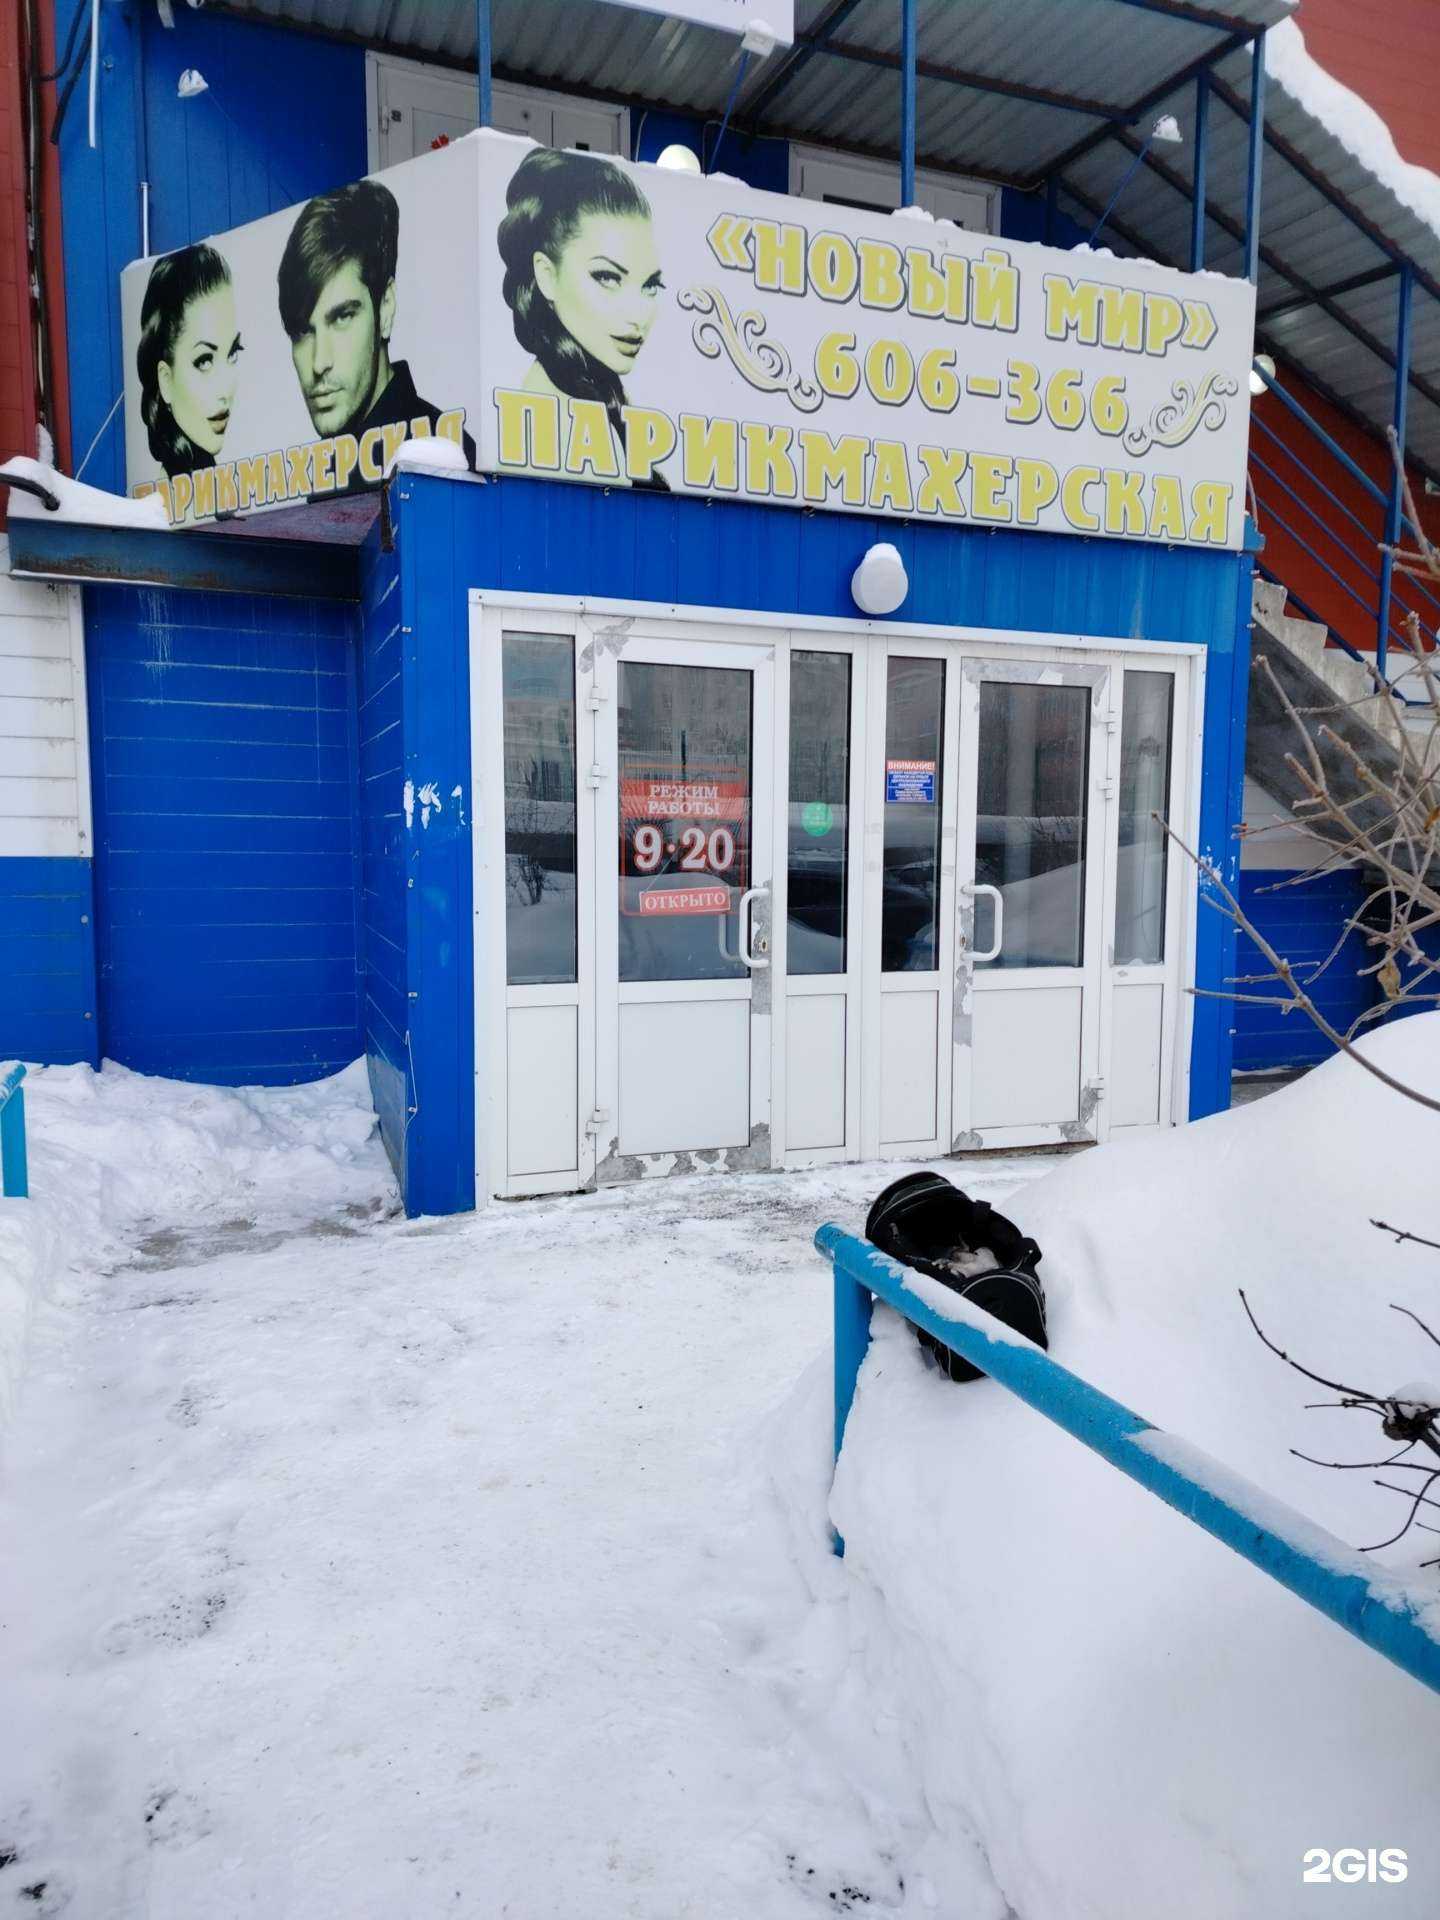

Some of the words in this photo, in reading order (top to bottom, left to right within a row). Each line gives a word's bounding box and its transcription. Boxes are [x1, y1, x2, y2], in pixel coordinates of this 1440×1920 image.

[706, 212, 1019, 332] «НОВЫЙ
[1043, 272, 1219, 357] МИР»
[814, 332, 1130, 437] 606-366
[492, 386, 1234, 545] ПАРИКМАХЕРСКАЯ
[647, 800, 720, 815] РАБОТЫ
[649, 784, 718, 799] РЕЖИМ
[644, 892, 726, 910] ОТКРЫТО
